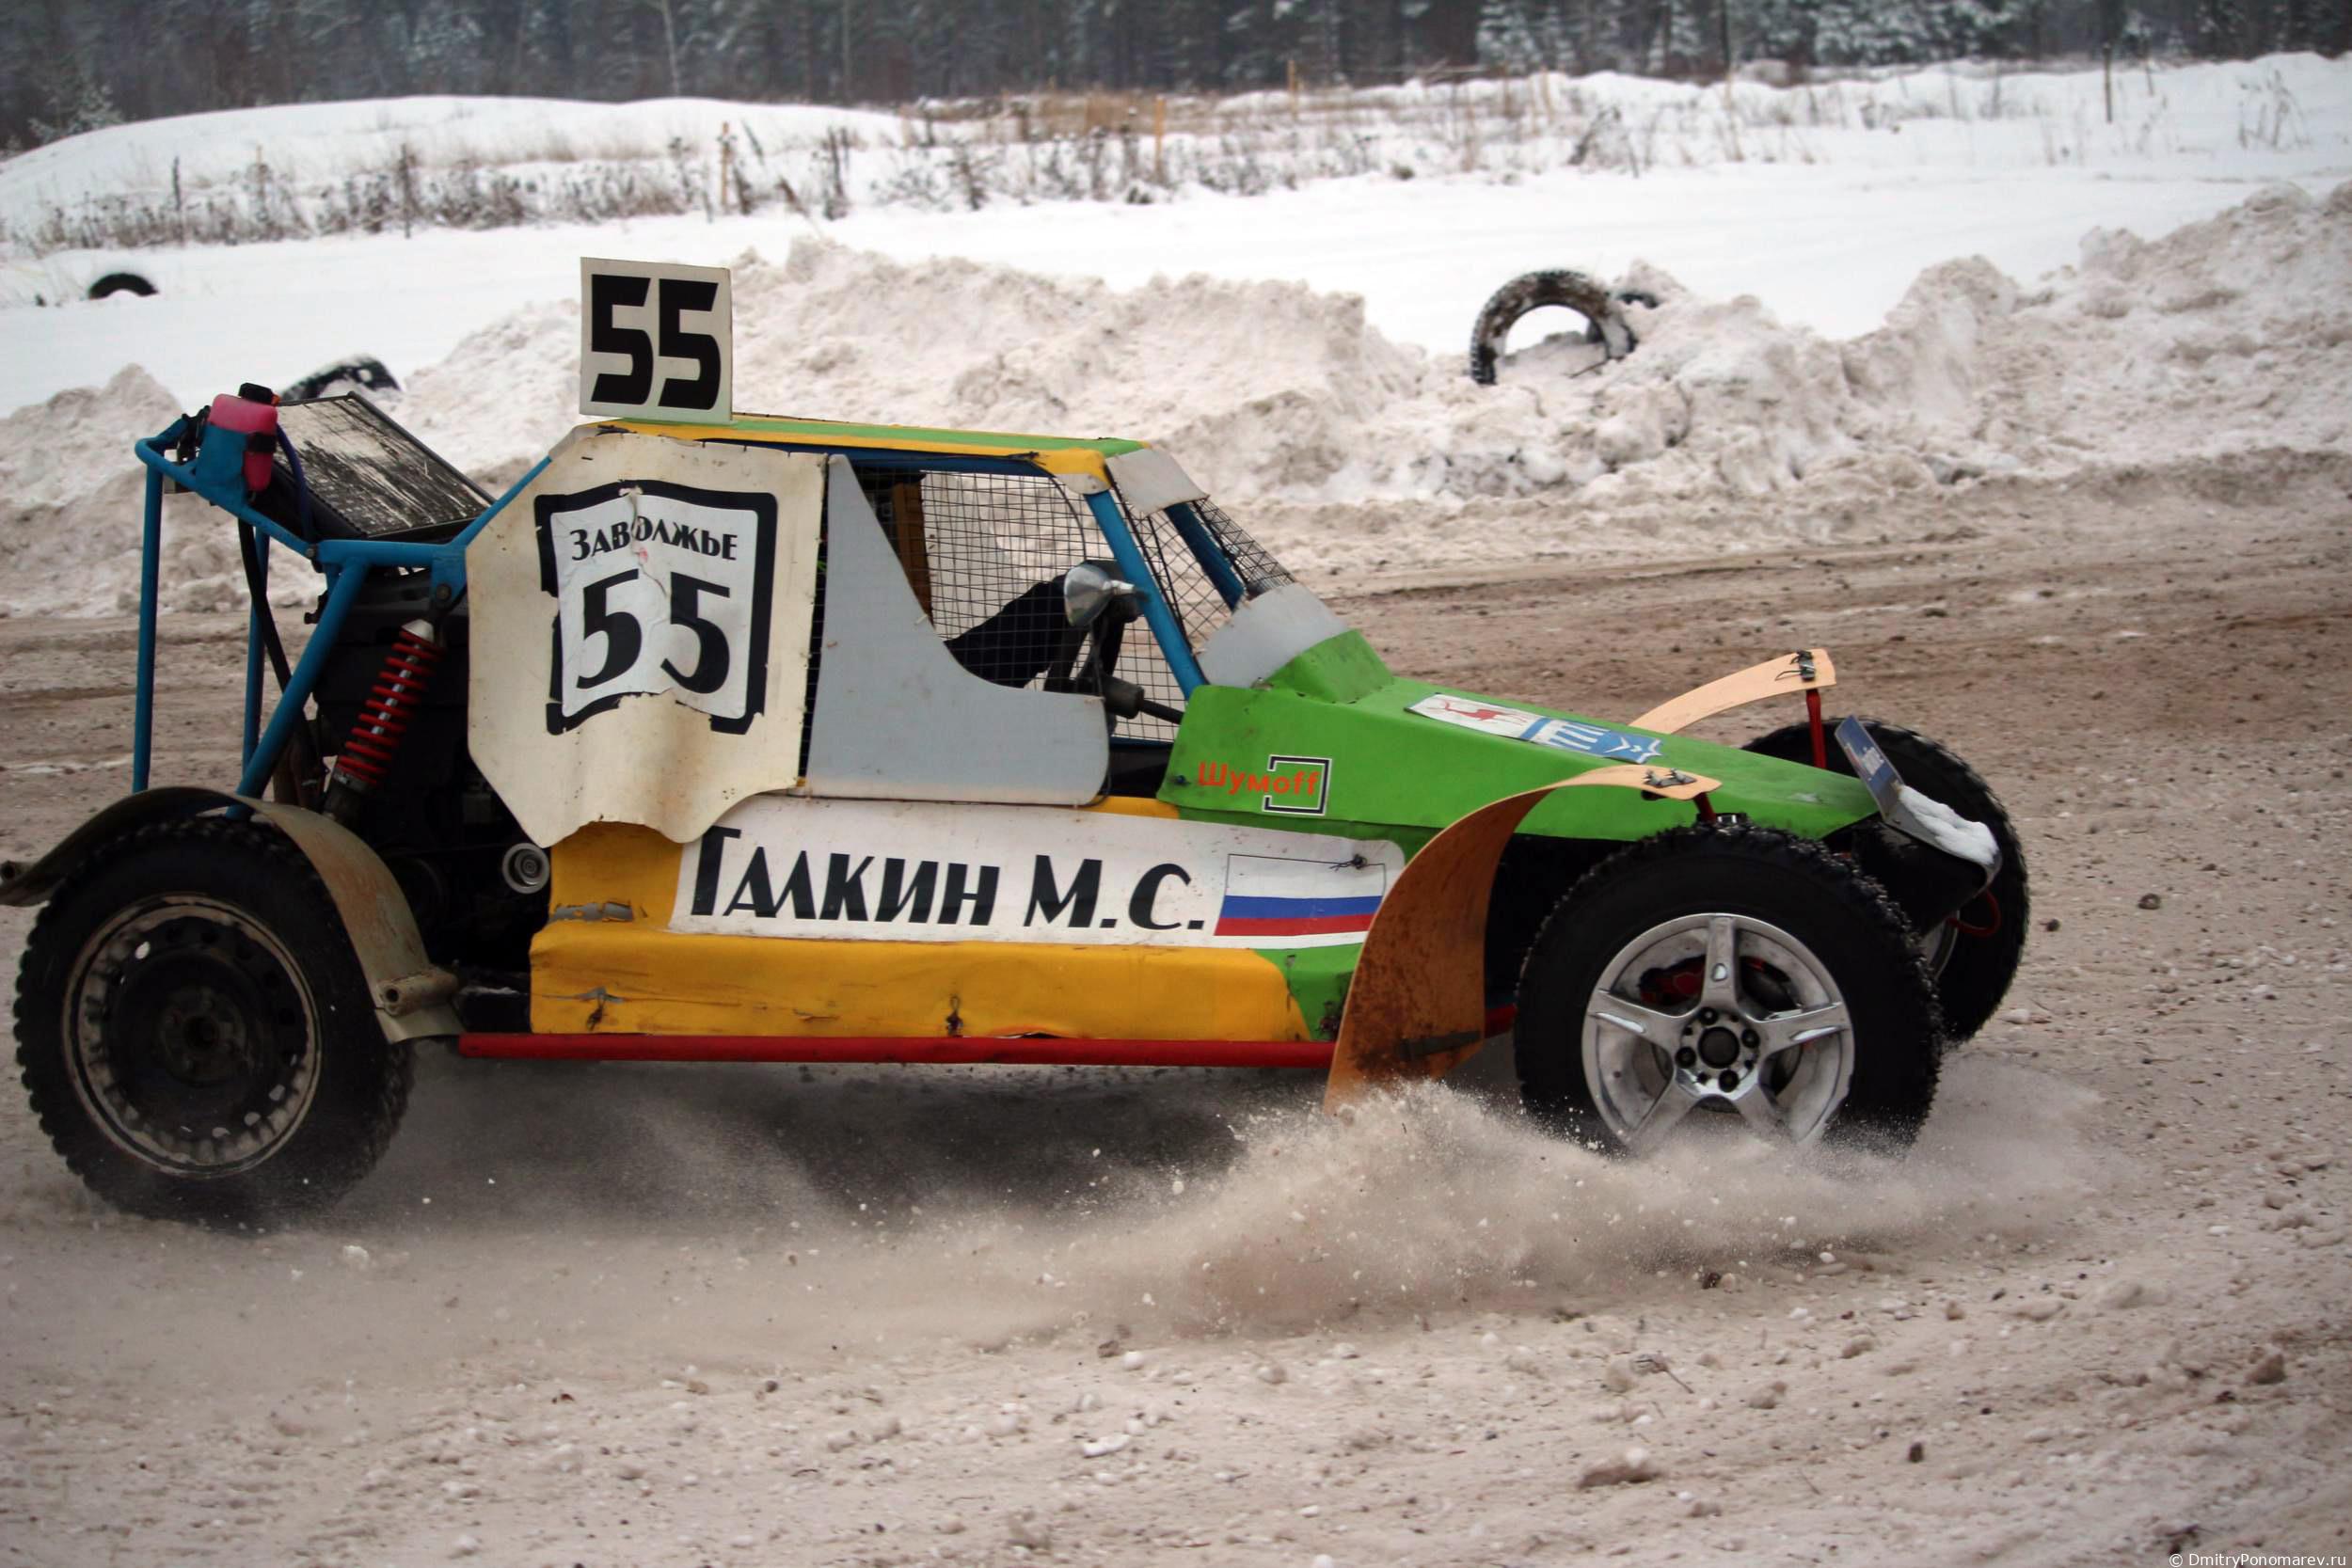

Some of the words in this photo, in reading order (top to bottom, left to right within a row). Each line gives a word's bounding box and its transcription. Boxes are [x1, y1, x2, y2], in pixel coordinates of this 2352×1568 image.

[591, 274, 722, 410] 55
[569, 515, 739, 562] ЗАВОЛЖЬЕ
[576, 568, 731, 694] 55
[690, 824, 1000, 927] ГАЛКИН
